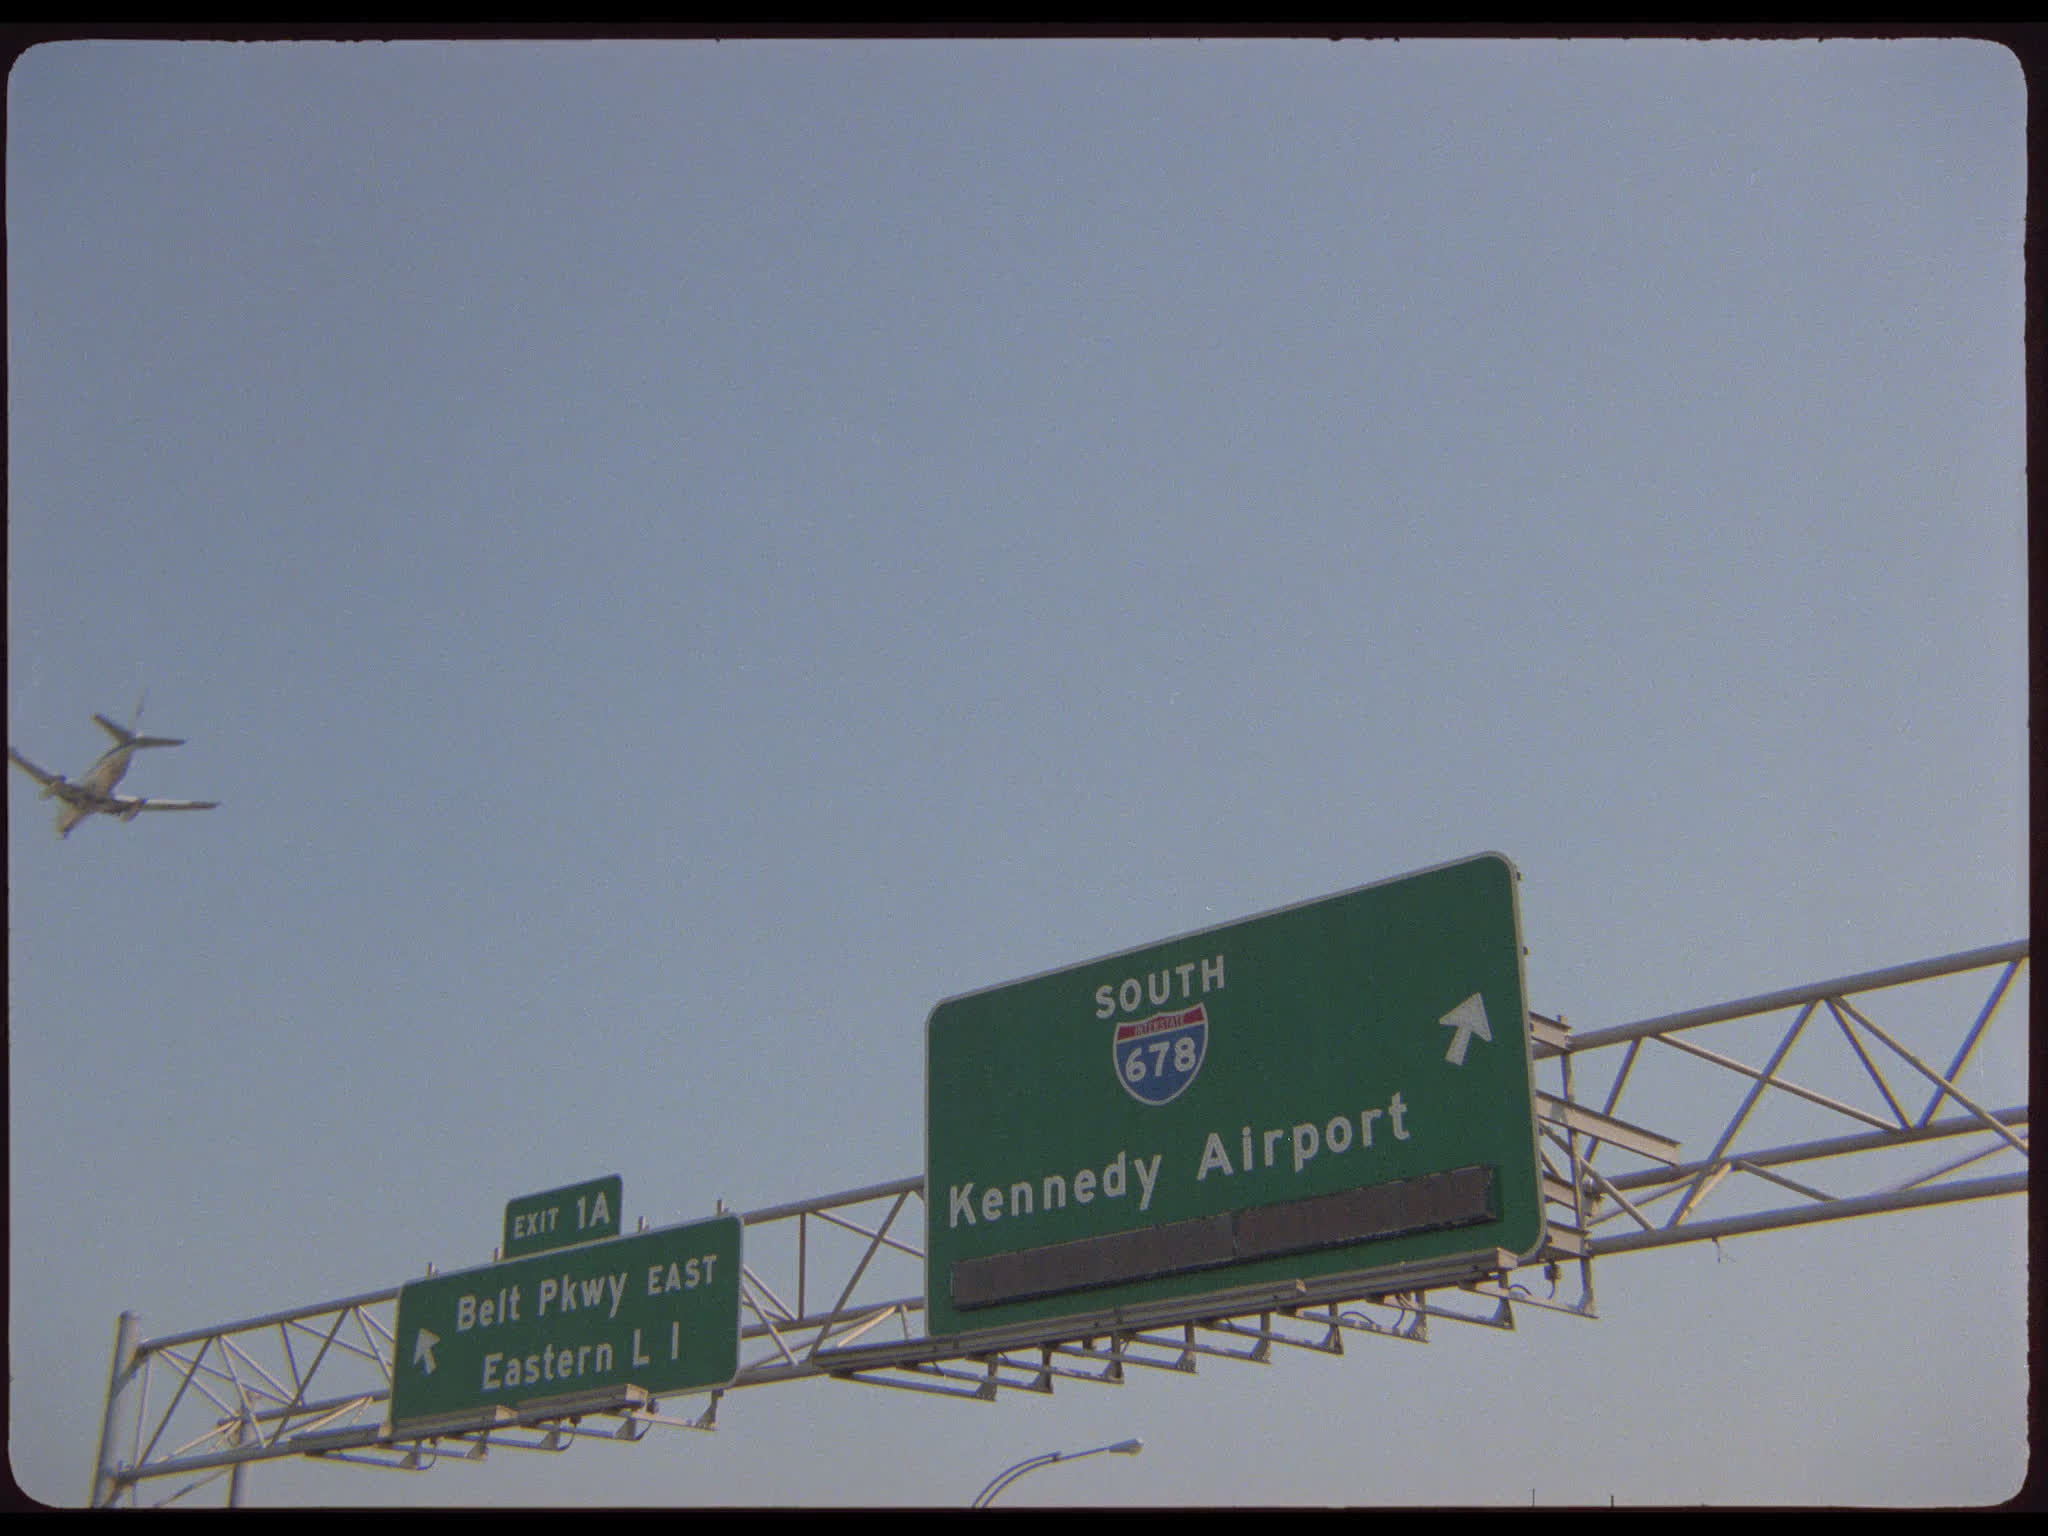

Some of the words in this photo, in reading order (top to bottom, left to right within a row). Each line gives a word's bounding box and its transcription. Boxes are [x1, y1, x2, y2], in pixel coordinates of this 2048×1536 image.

[1095, 954, 1225, 1018] SOUTH
[1125, 1037, 1196, 1082] 678
[949, 1151, 1161, 1228] Kennedy
[1196, 1092, 1410, 1181] Airport
[514, 1206, 559, 1239] EXIT
[576, 1191, 611, 1229] 1A
[456, 1287, 521, 1332] Belt
[538, 1272, 628, 1318] Pkwy
[647, 1254, 718, 1296] EAST
[481, 1342, 613, 1391] Eastern
[632, 1328, 650, 1368] L
